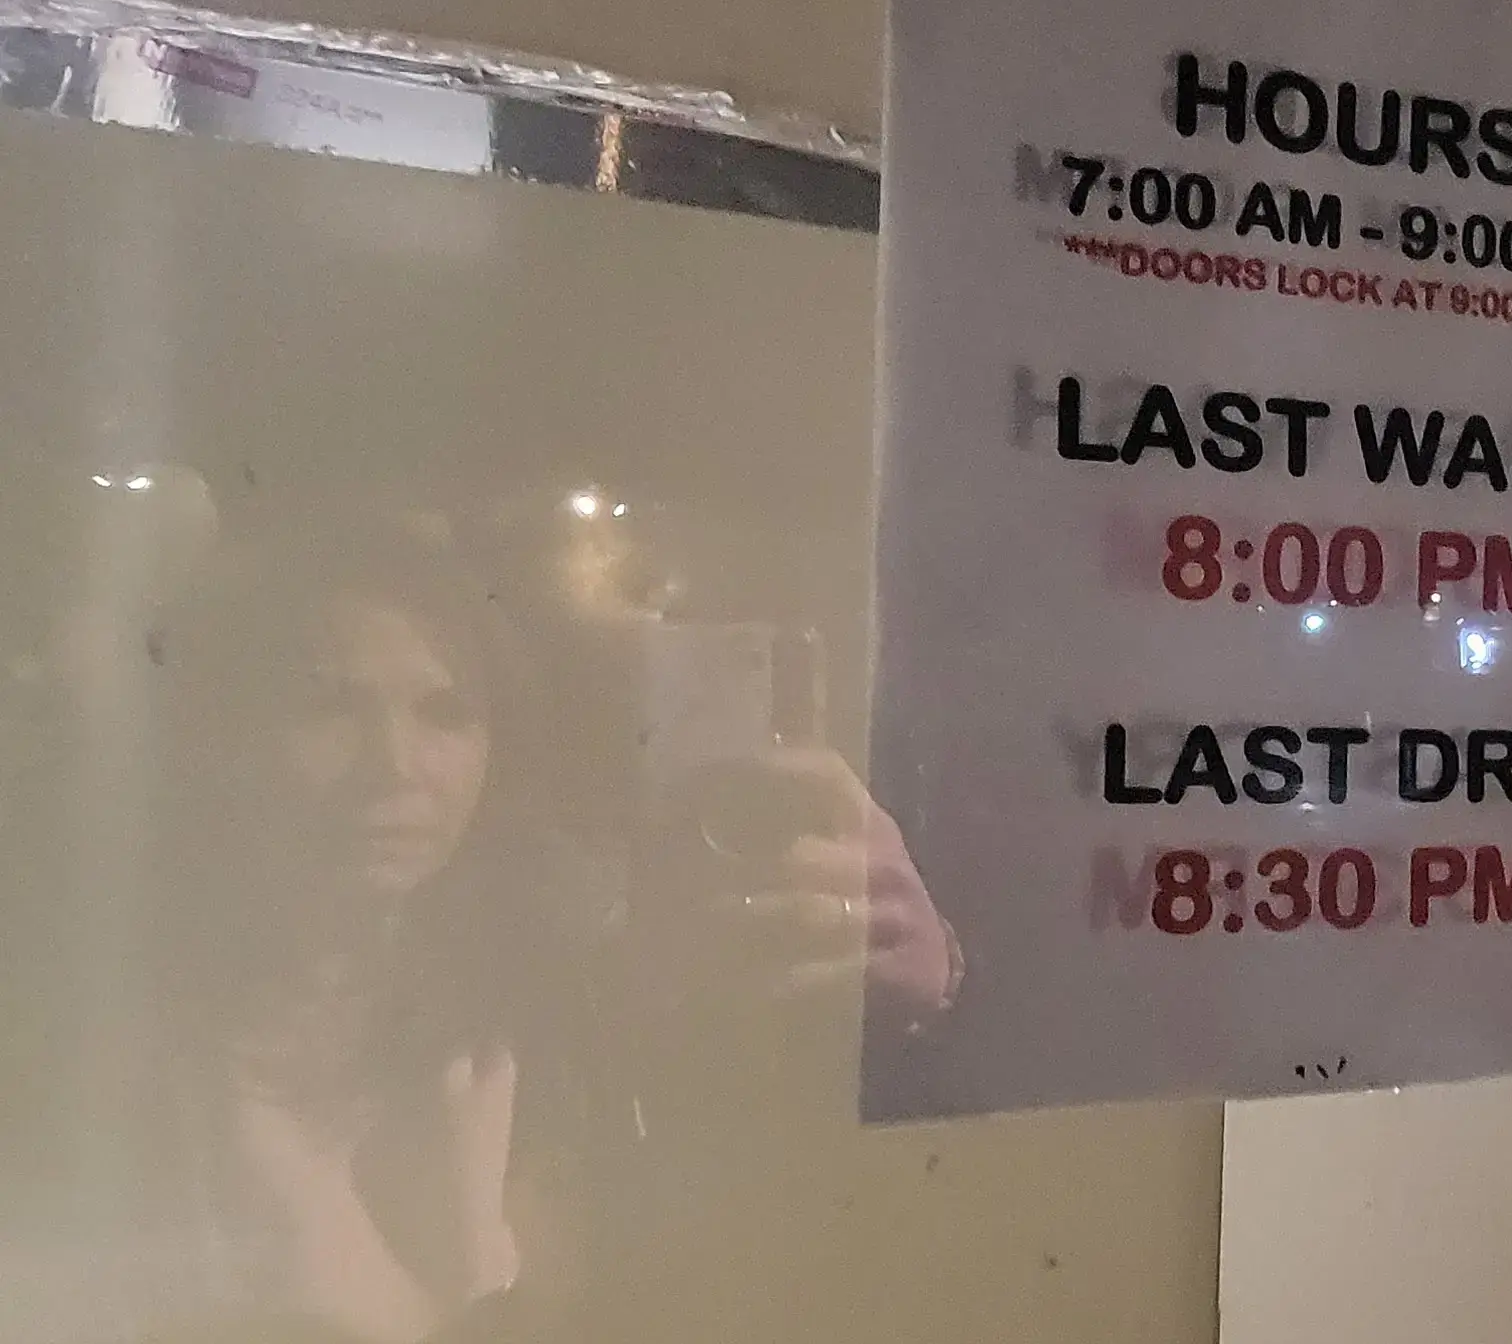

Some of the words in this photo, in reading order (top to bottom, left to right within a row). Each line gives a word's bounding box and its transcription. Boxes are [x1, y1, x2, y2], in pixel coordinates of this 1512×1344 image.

[1061, 155, 1216, 230] 7:00
[1235, 182, 1342, 249] AM
[1360, 227, 1384, 241] -
[1277, 266, 1383, 304] LOCK
[1393, 279, 1441, 311] AT
[1056, 377, 1330, 477] LAST
[1161, 514, 1384, 606] 8:00
[1103, 723, 1370, 805] LAST
[1151, 847, 1377, 935] 8:30
